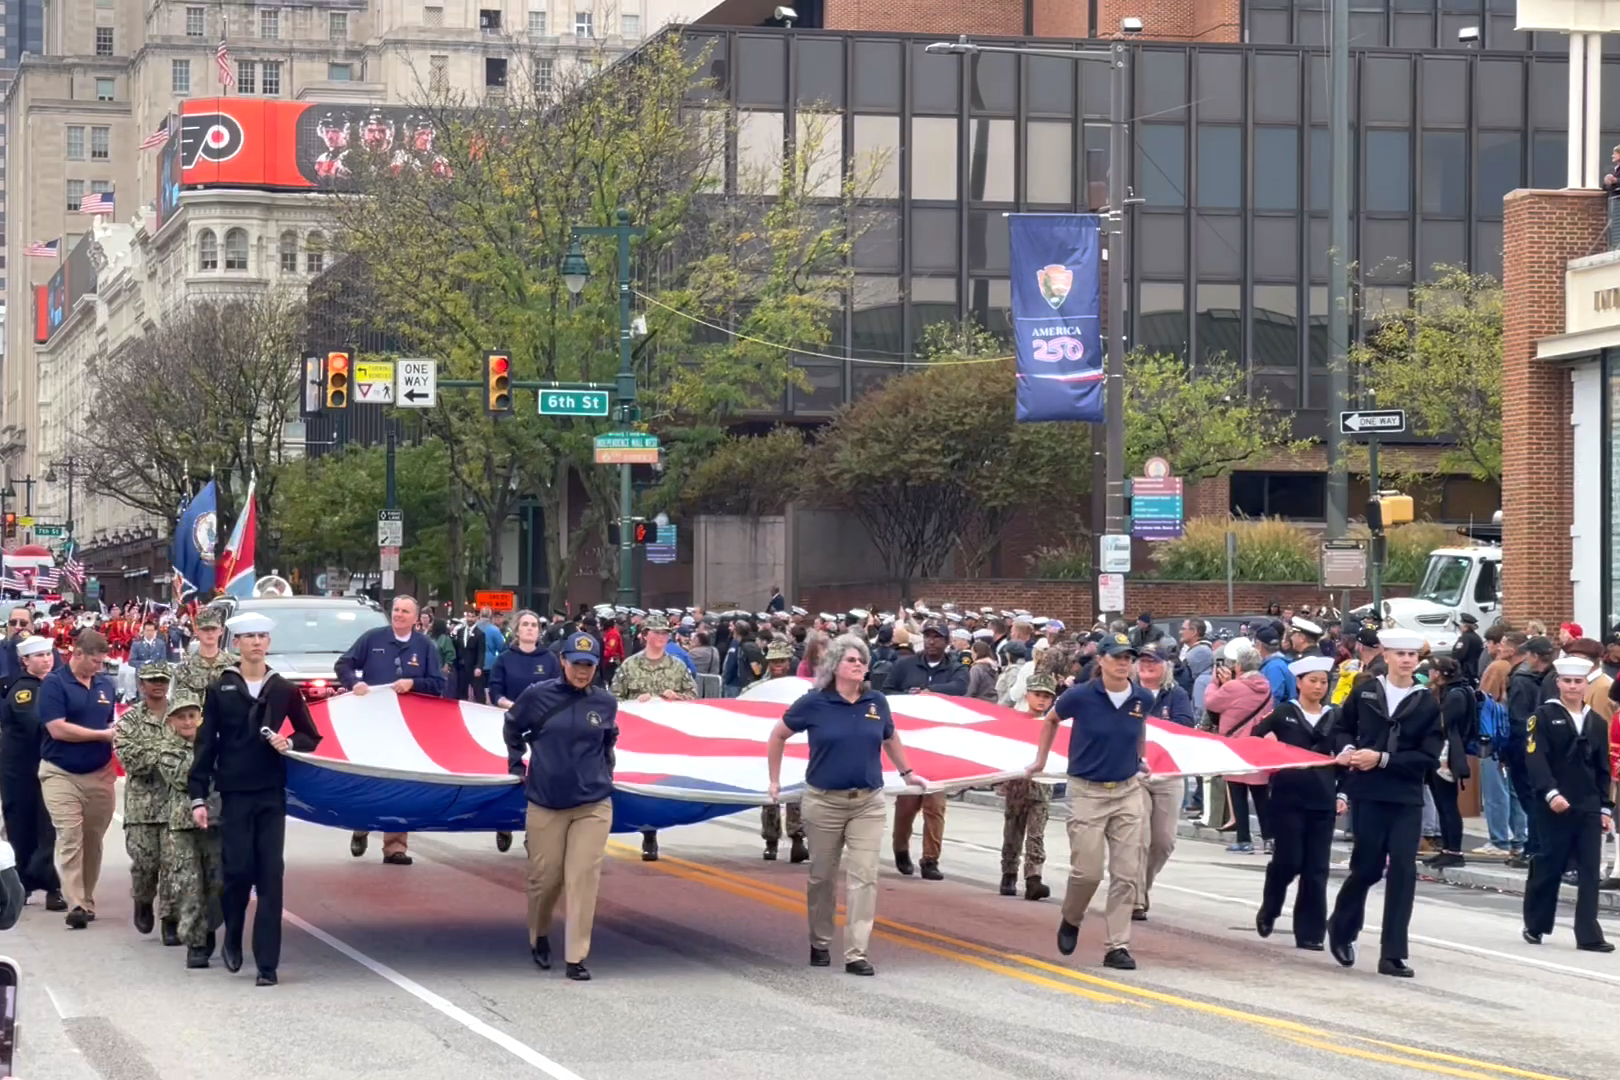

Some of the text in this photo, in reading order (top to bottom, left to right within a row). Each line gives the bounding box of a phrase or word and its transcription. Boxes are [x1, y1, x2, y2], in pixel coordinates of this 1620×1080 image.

[1031, 326, 1082, 337] AMERICA
[1032, 336, 1084, 362] 250
[404, 363, 428, 374] ONE
[404, 376, 429, 386] WAY
[548, 395, 600, 409] 6th St
[1360, 416, 1397, 426] ONE WAY
[596, 437, 658, 447] INDEPENDENCE MALL WEST
